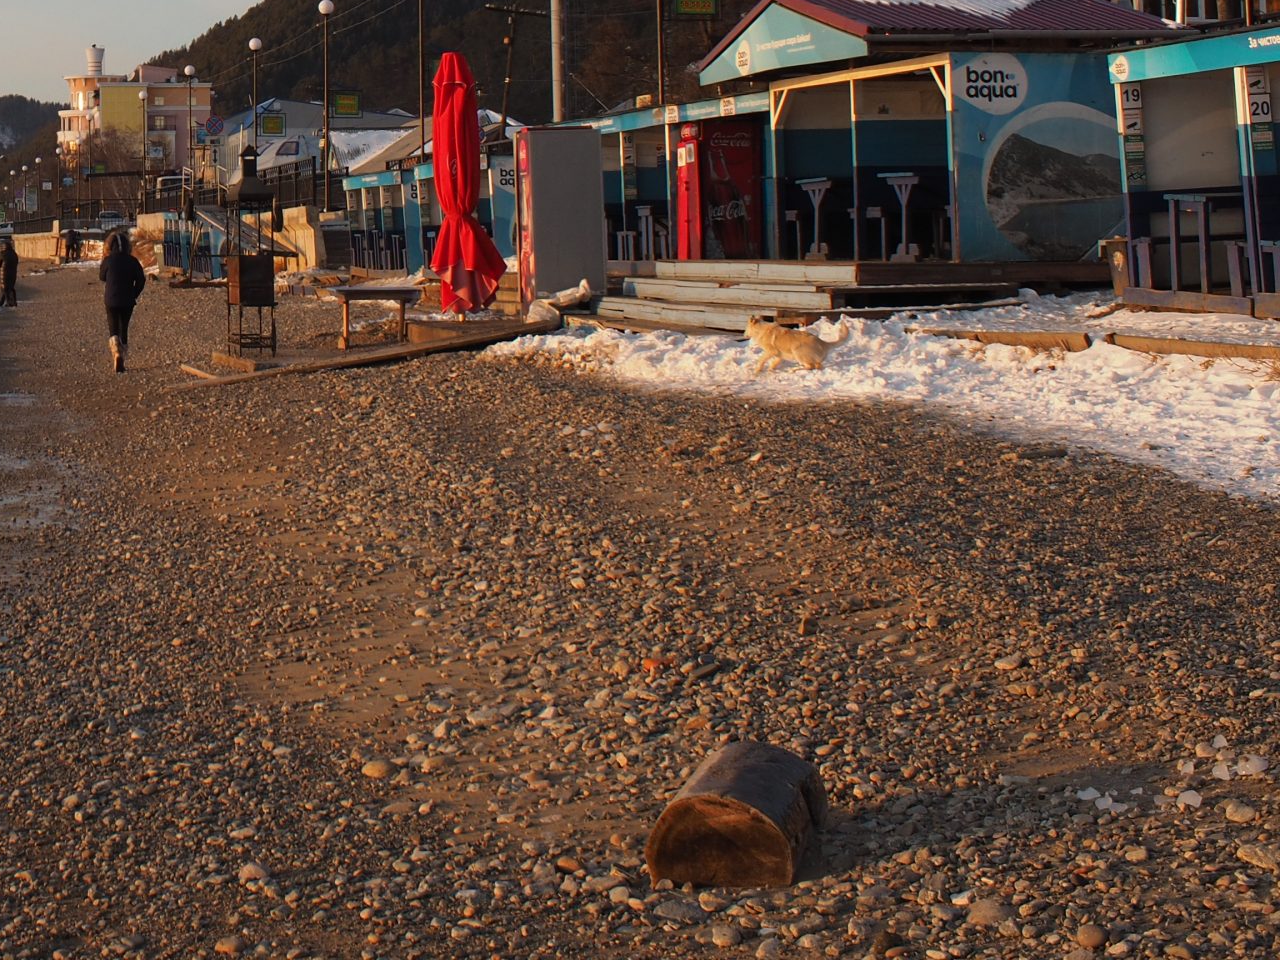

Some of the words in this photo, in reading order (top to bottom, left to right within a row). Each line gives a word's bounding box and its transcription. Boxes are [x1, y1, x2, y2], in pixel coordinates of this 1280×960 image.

[1248, 37, 1258, 49] За
[966, 66, 1004, 83] bon
[966, 85, 1017, 102] aqua
[1123, 88, 1140, 102] 19
[1251, 101, 1270, 116] 20
